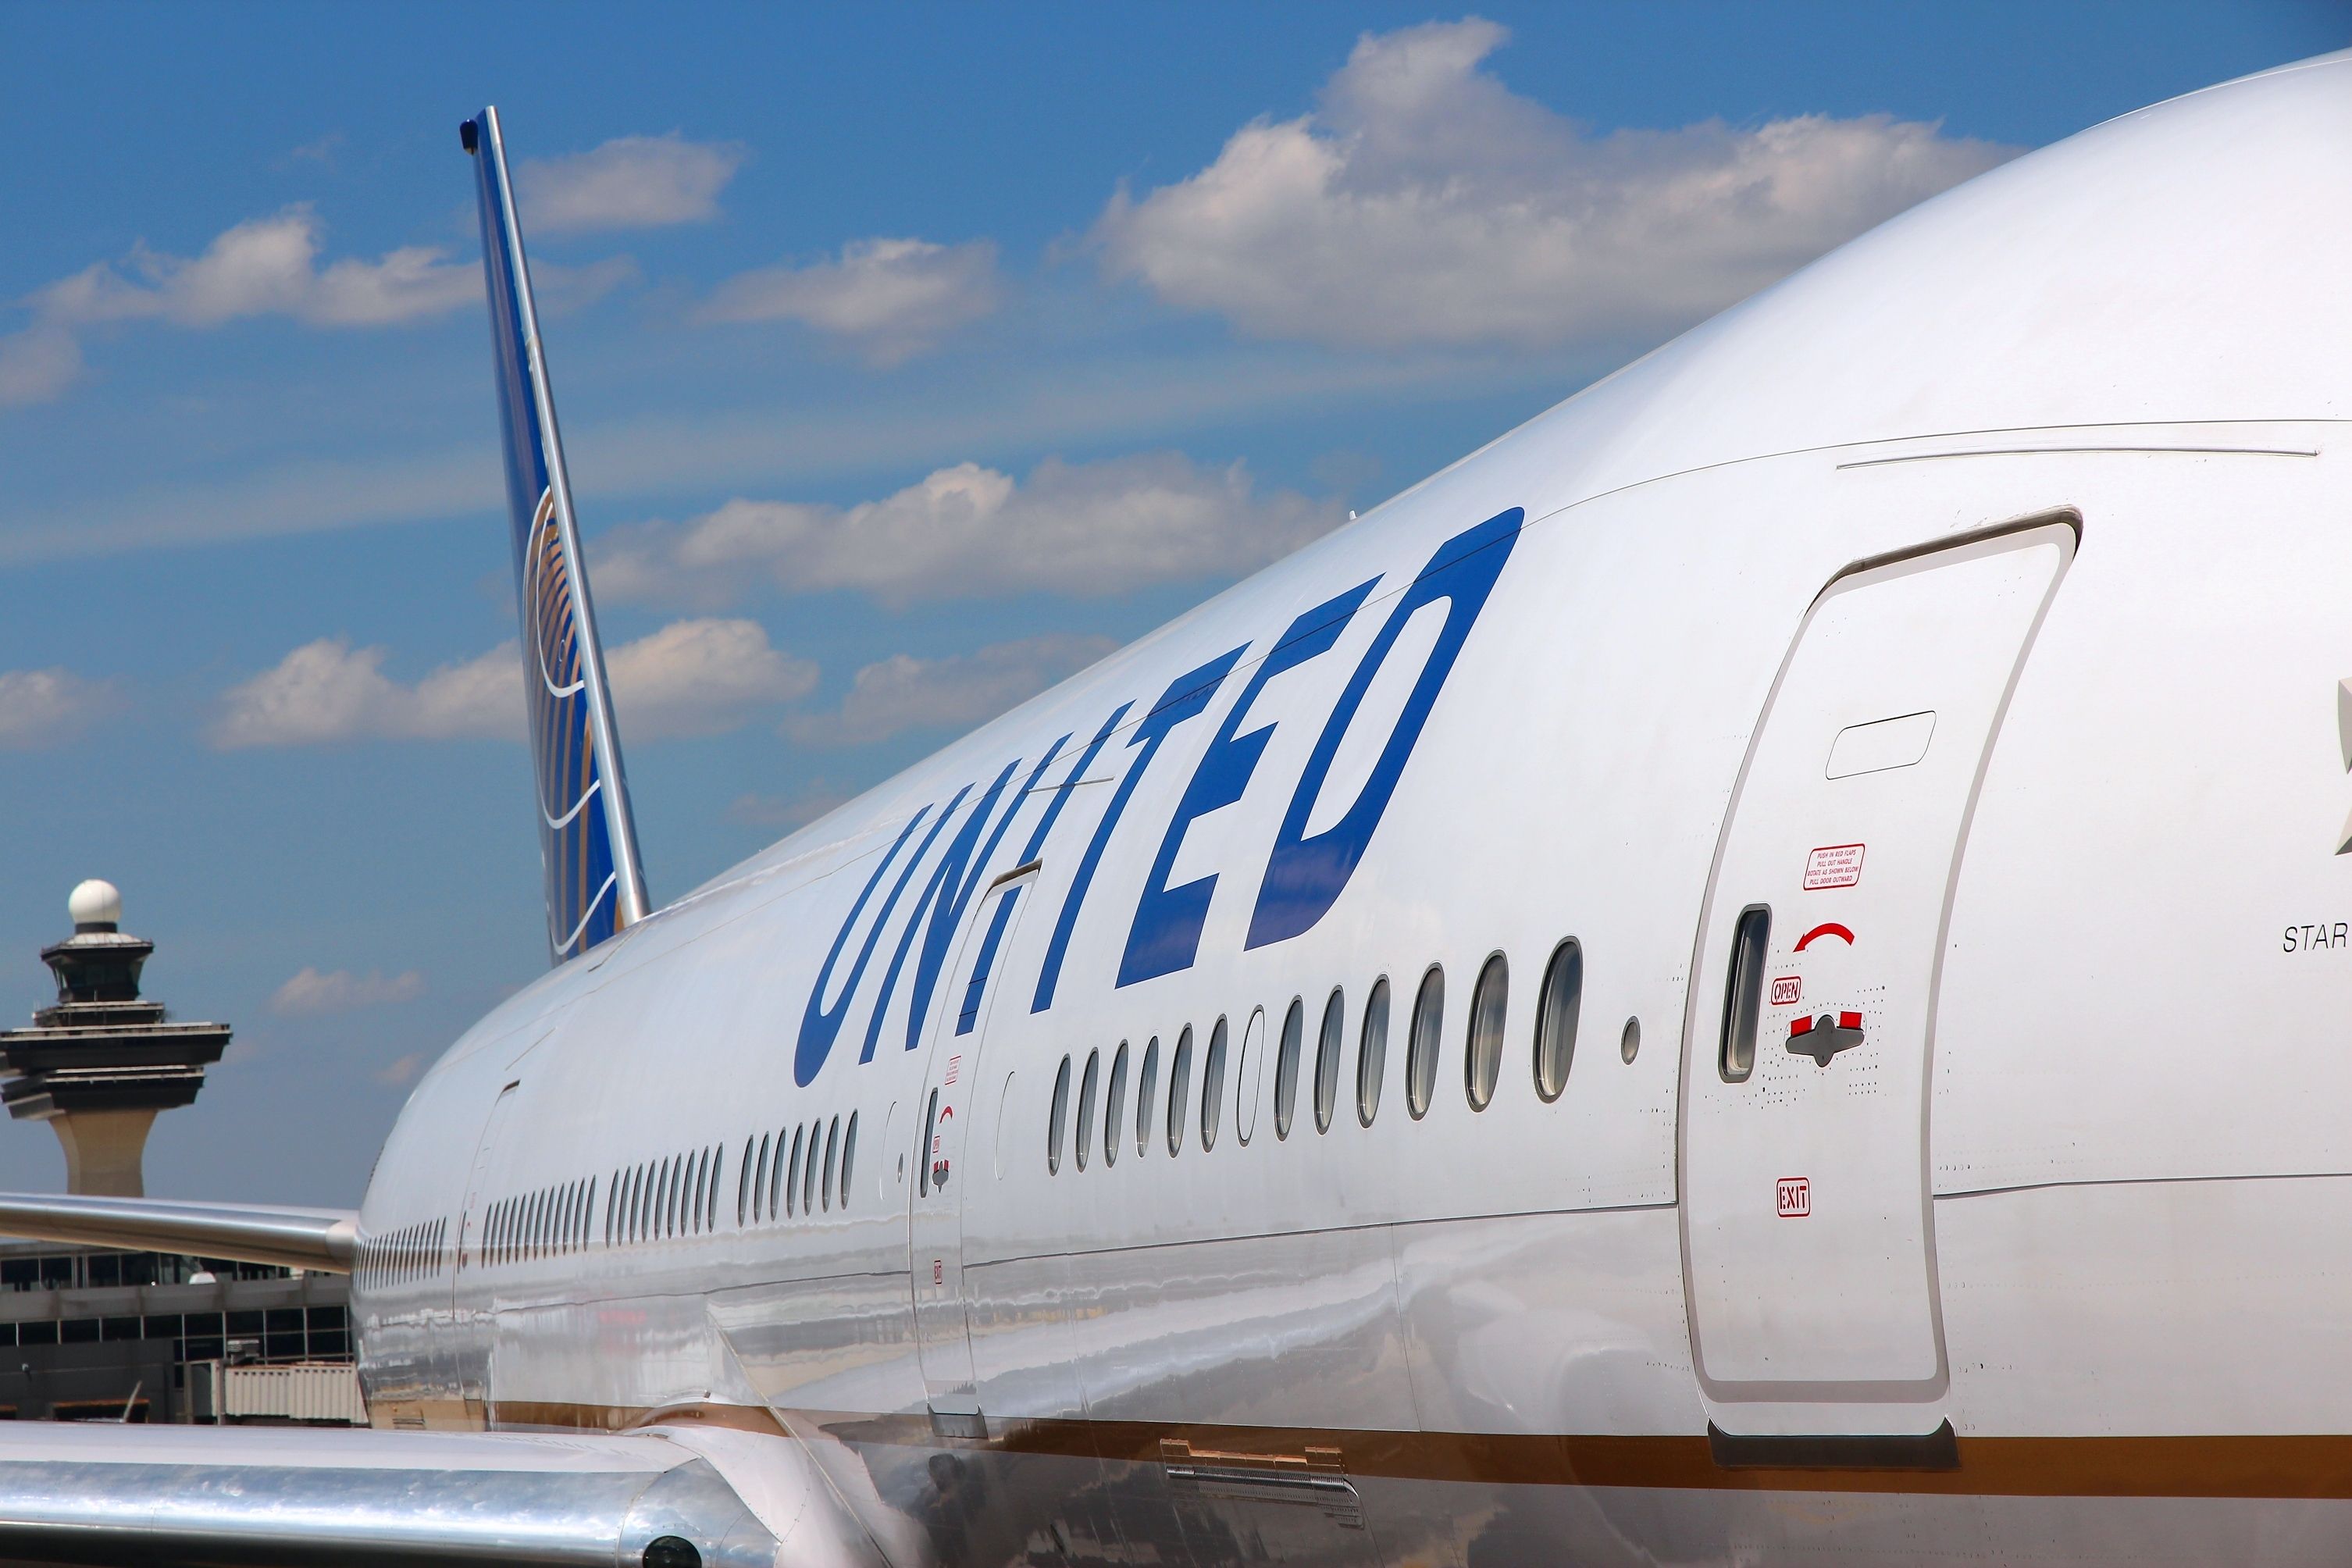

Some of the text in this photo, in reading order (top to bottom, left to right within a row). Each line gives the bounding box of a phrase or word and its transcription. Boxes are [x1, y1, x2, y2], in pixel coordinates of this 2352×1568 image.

[793, 506, 1525, 1089] UNITED
[2283, 922, 2348, 953] STAR
[1774, 982, 1799, 1000] OPEN
[1780, 1185, 1807, 1209] EXIT
